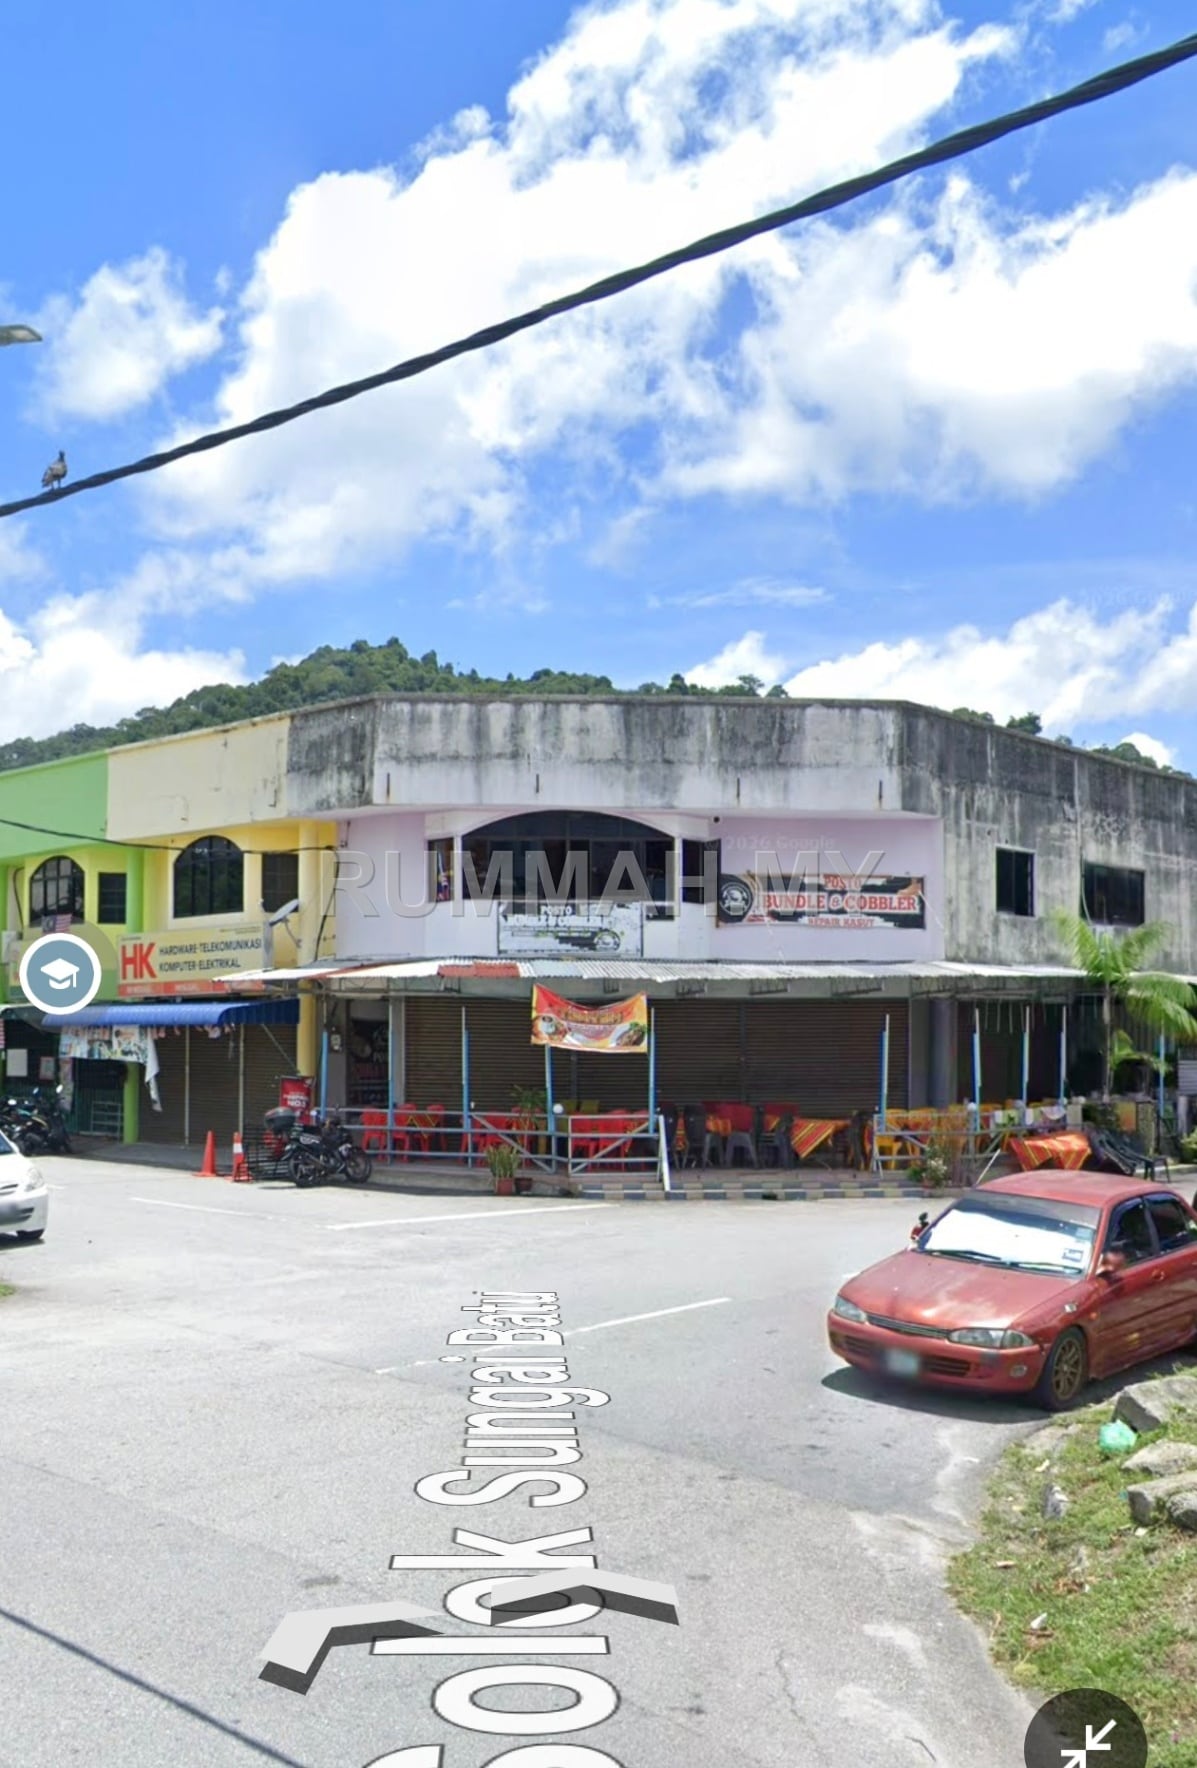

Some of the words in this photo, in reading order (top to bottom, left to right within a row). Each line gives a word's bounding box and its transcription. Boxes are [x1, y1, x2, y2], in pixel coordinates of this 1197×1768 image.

[823, 874, 862, 891] POSTO
[764, 894, 825, 911] BUNDLE
[845, 894, 917, 912] COBBLER
[807, 917, 839, 929] REPAIR
[843, 917, 875, 929] KASUT
[120, 942, 157, 980] HK
